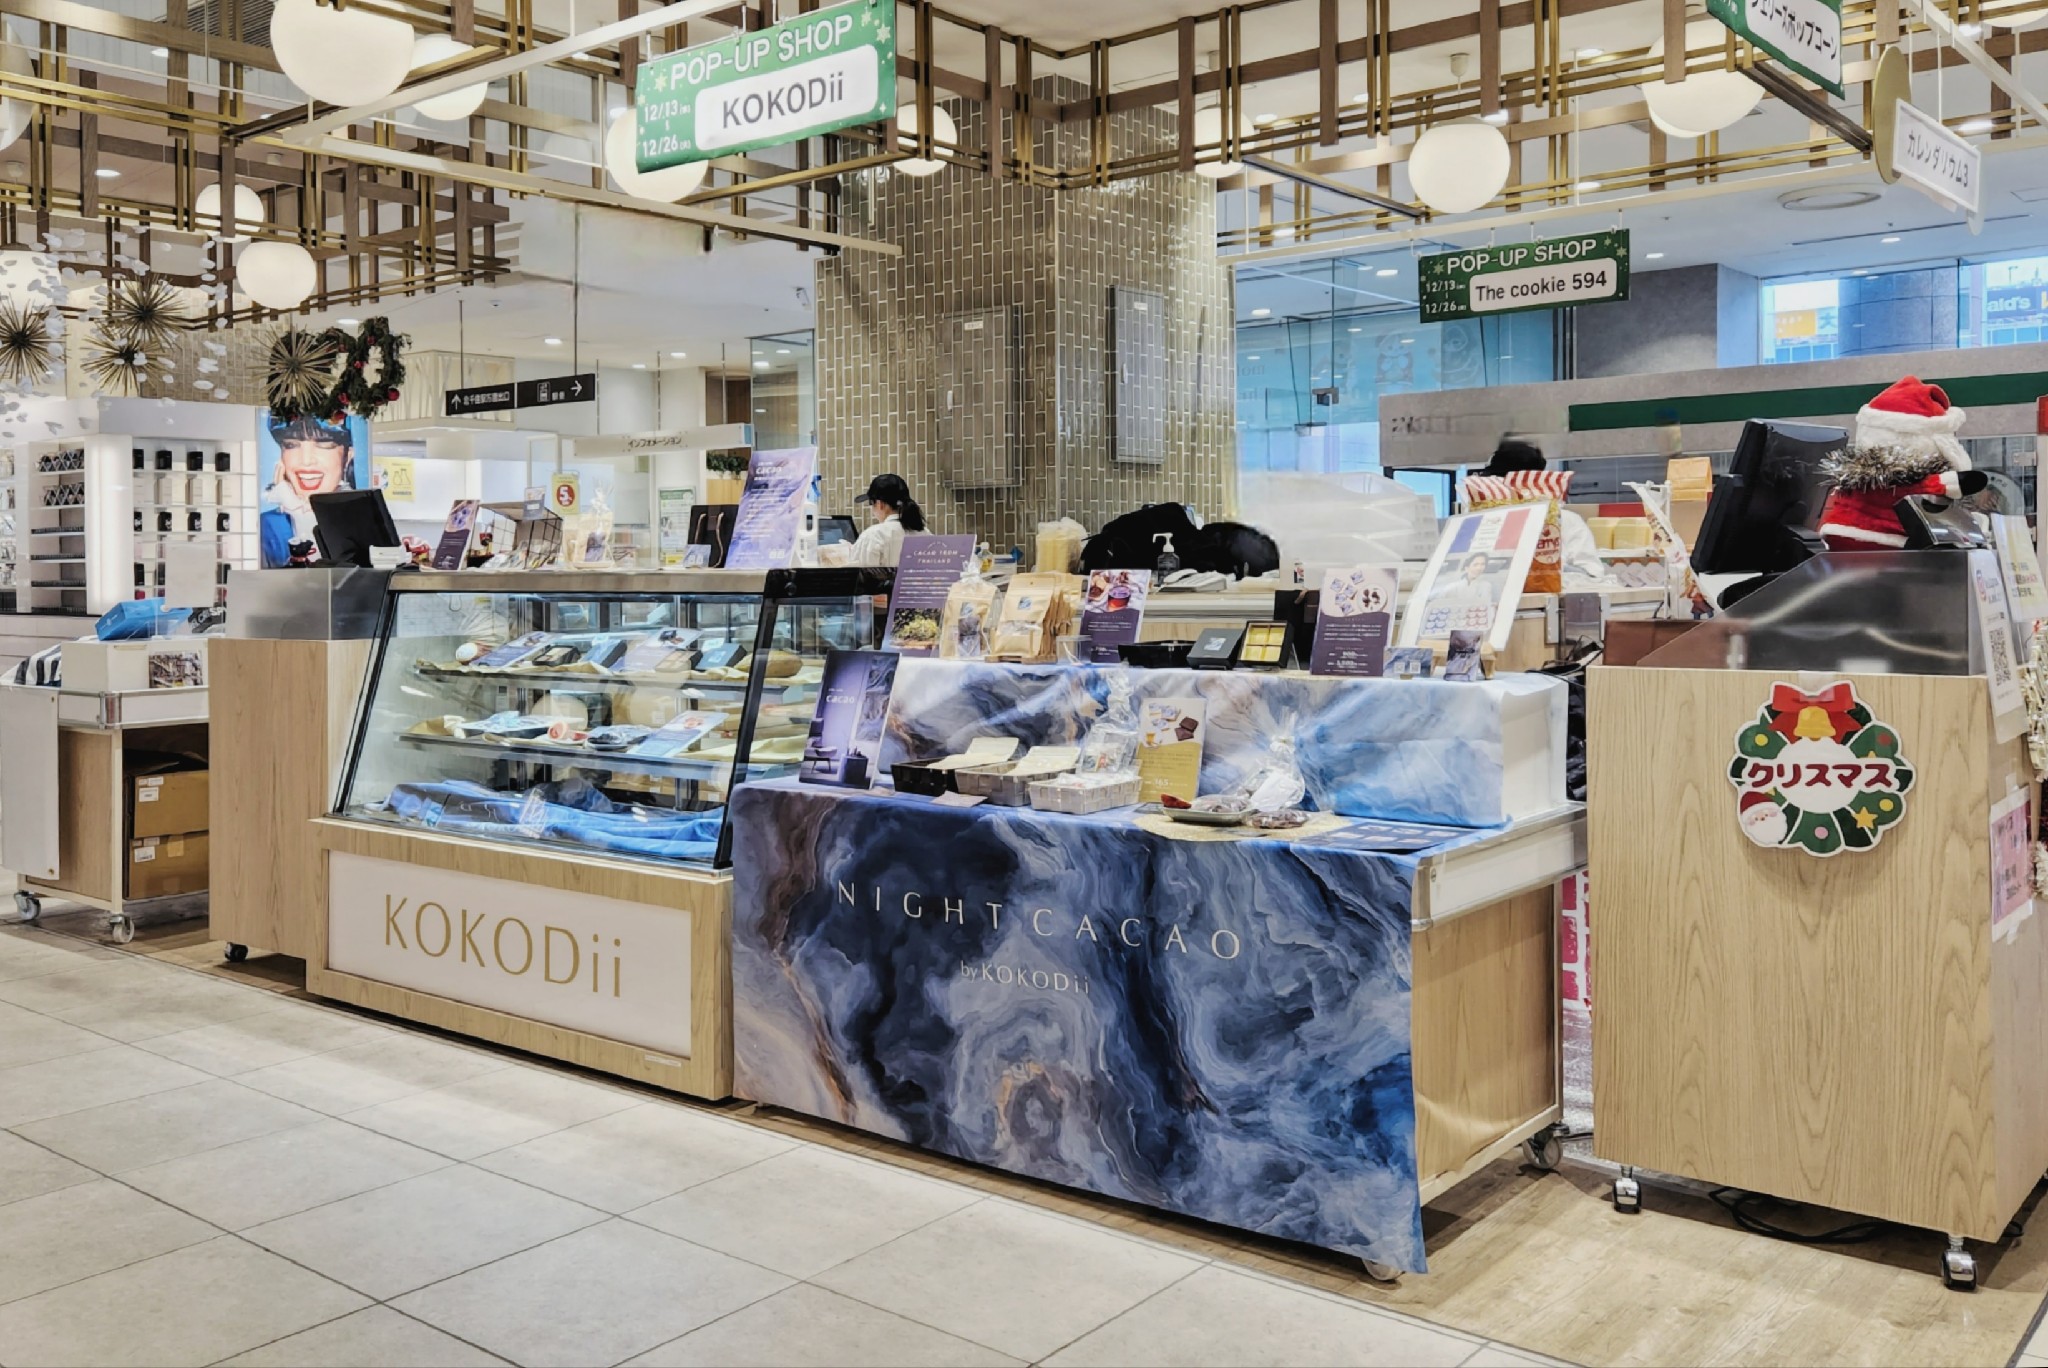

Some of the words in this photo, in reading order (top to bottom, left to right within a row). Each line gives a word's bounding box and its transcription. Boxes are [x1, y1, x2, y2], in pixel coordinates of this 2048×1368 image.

[670, 37, 770, 91] POP-UP
[778, 14, 853, 63] SHOP
[722, 71, 844, 130] KOKODii
[1447, 247, 1528, 275] POP-UP
[1534, 238, 1597, 262] SHOP
[1475, 285, 1505, 302] The
[1510, 276, 1565, 298] cookie
[1572, 270, 1607, 290] 594
[1747, 762, 1893, 790] クリスマス
[837, 880, 1003, 931] NIGHT
[1032, 908, 1241, 960] CACAO
[384, 893, 622, 998] KOKODii
[960, 959, 979, 984] by
[981, 963, 1091, 995] KOKODii
